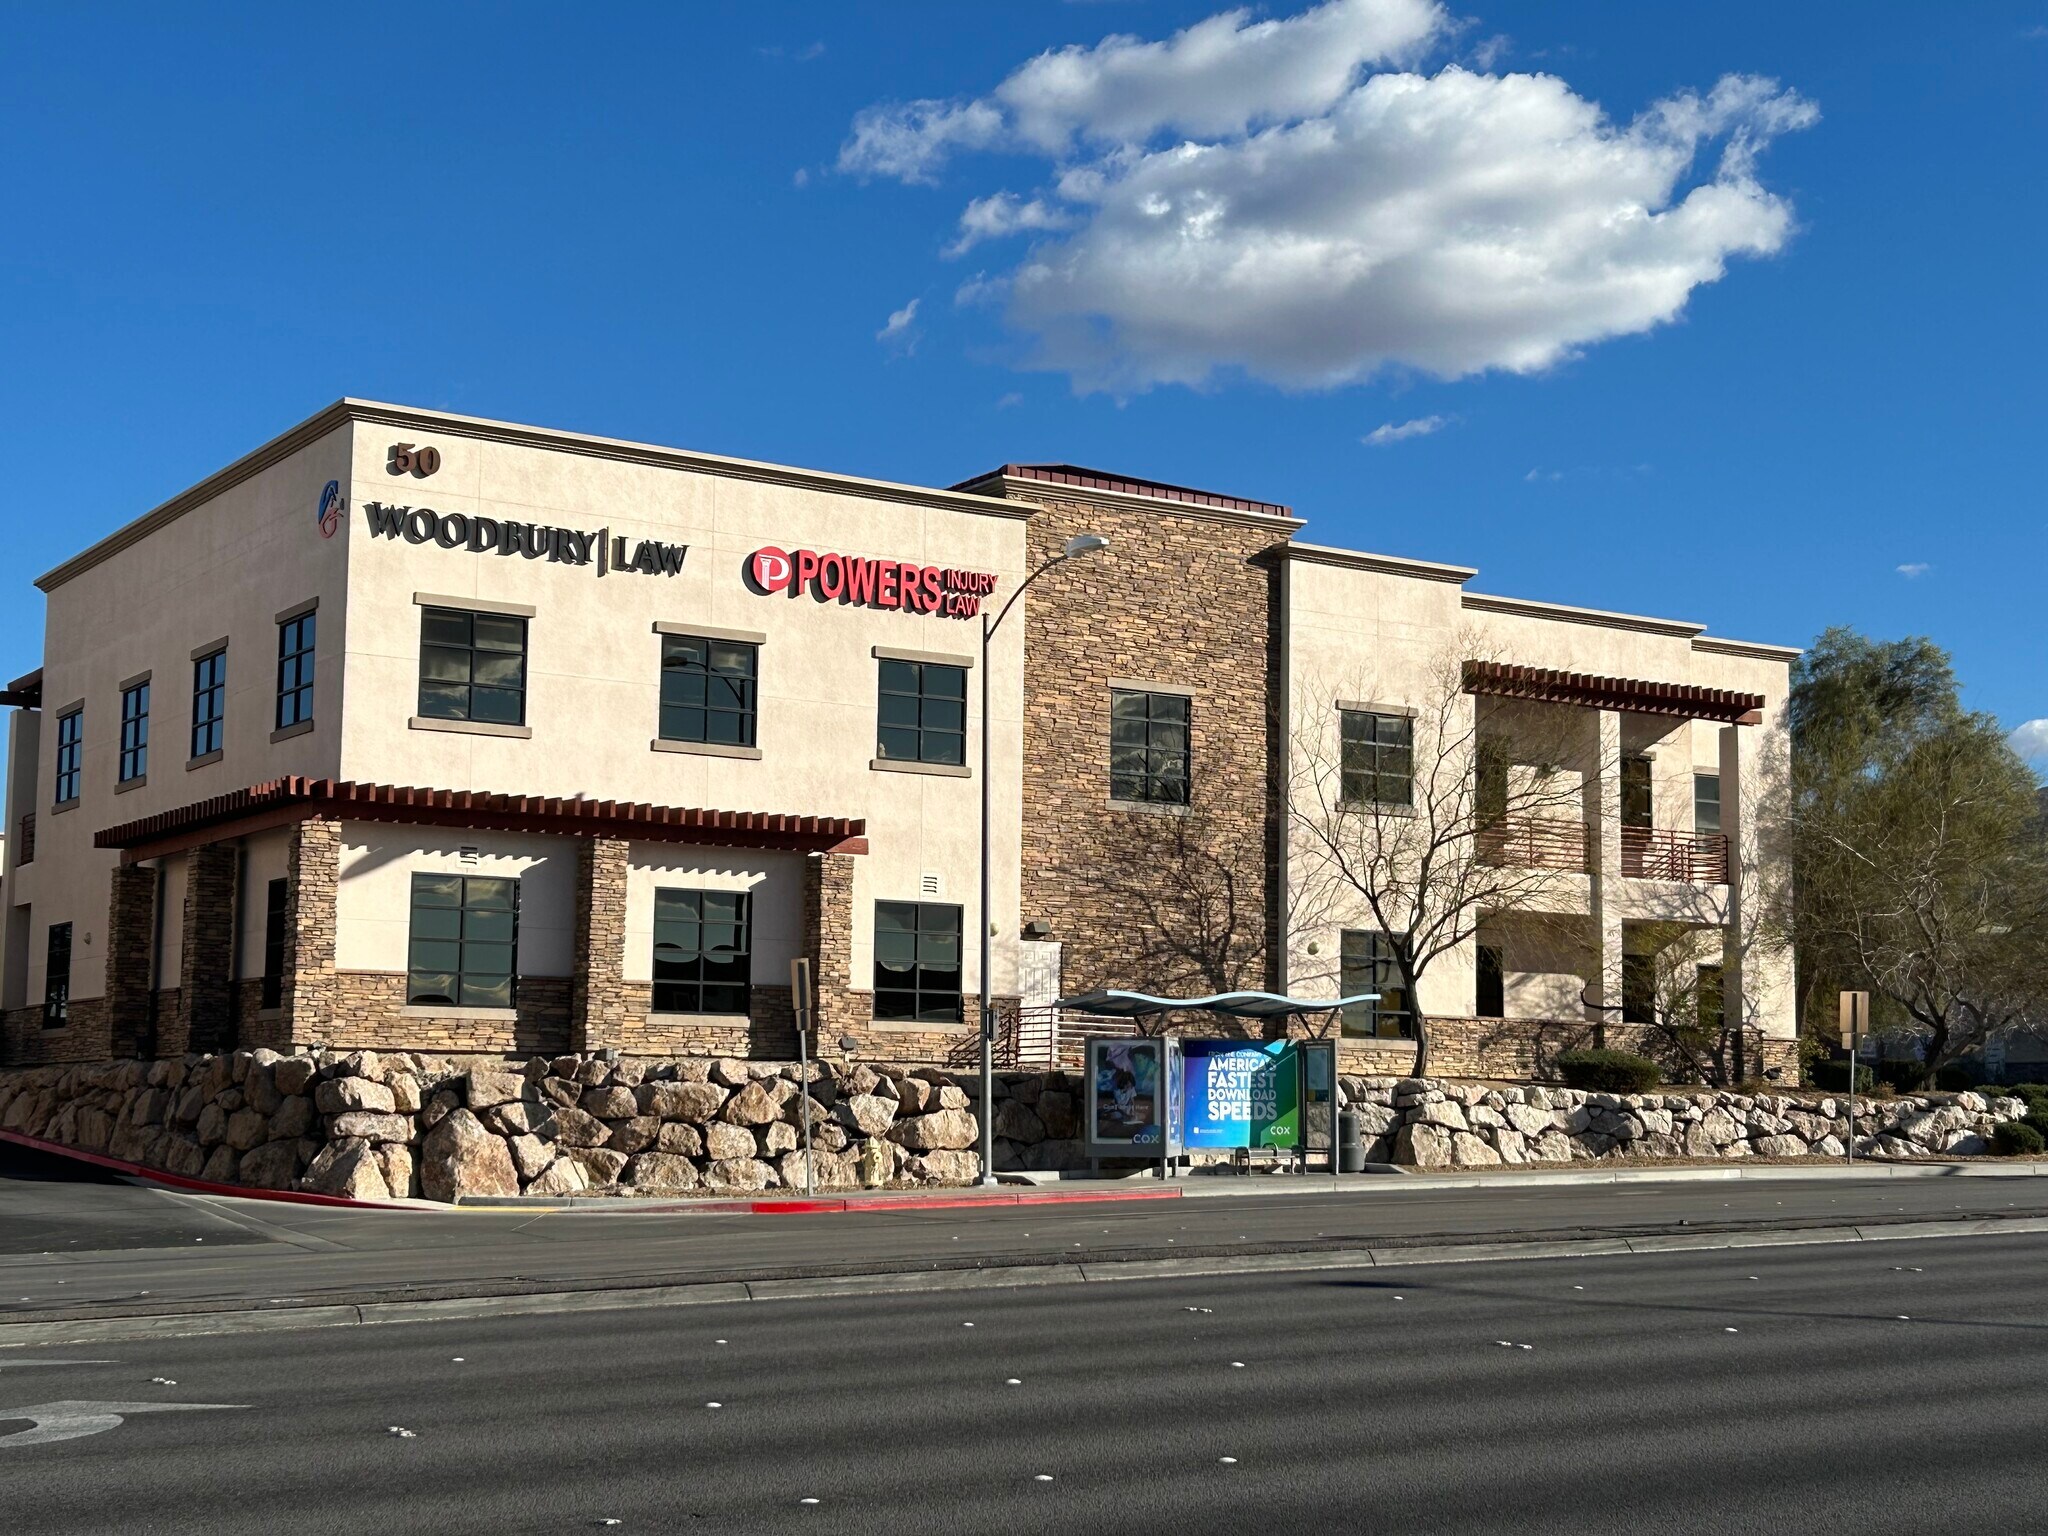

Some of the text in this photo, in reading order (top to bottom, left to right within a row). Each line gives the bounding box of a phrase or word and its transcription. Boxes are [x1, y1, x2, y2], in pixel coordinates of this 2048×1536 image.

[391, 442, 441, 477] 50
[367, 501, 690, 576] WOODBURY LAW
[796, 549, 942, 611] POWERS
[946, 569, 999, 594] INJURY
[946, 594, 982, 615] LAW
[1207, 1071, 1277, 1089] FASTEST
[1207, 1088, 1277, 1101] DOWNLOAD
[1207, 1100, 1278, 1121] SPEEDS
[1133, 1133, 1160, 1144] COX
[1269, 1126, 1291, 1135] COX
